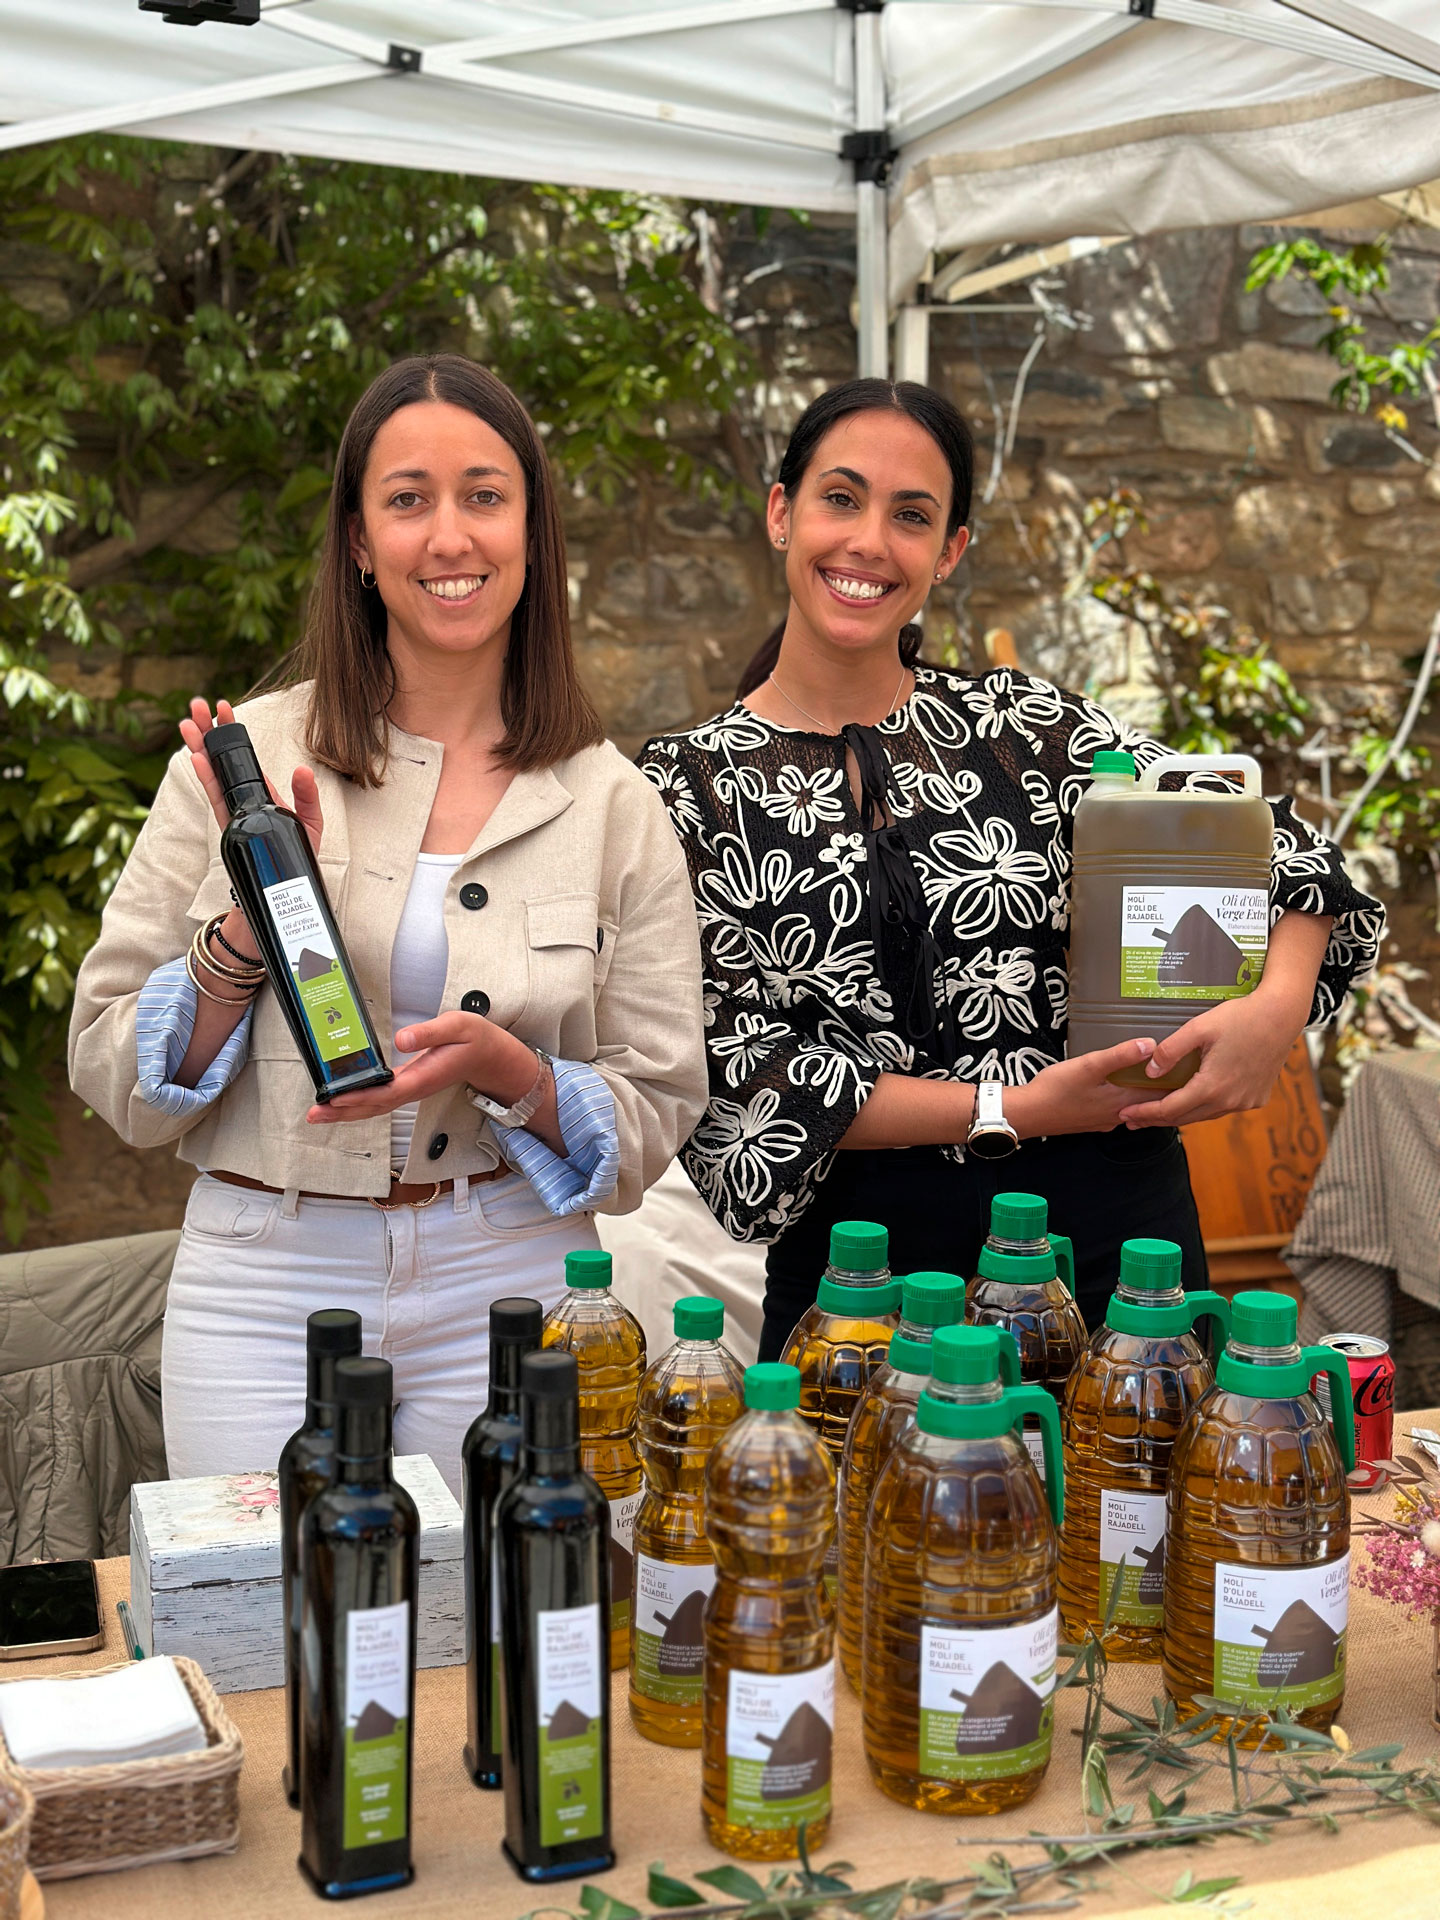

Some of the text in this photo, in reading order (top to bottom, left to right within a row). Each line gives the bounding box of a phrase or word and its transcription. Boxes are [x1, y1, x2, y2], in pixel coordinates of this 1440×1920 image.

[272, 890, 289, 902] MOLÍ
[1128, 895, 1145, 903] MOLÍ
[1222, 895, 1266, 907] Oli d'Oliva
[275, 899, 293, 910] D'OLI
[277, 902, 312, 917] RAJADELL
[1217, 908, 1266, 921] Verge Extra
[303, 922, 320, 931] Extra
[621, 1502, 634, 1515] Oli
[1108, 1503, 1126, 1511] MOLÍ
[1108, 1511, 1126, 1520] D'OLI
[617, 1516, 633, 1528] Ver
[1108, 1520, 1146, 1530] RAJADELL
[641, 1566, 655, 1578] MOLÍ
[1325, 1570, 1337, 1585] Oli
[641, 1575, 656, 1587] D'OLI
[1224, 1577, 1243, 1587] MOLÍ
[641, 1585, 674, 1600] RAJADELL
[1224, 1587, 1257, 1598] D'OLI DE
[1321, 1583, 1341, 1599] Verge
[1224, 1596, 1264, 1608] RAJADELL
[1034, 1628, 1045, 1643] Oli
[356, 1640, 400, 1652] RAJADELL
[547, 1641, 590, 1652] RAJADELL
[930, 1640, 950, 1650] MOLÍ
[1030, 1641, 1049, 1658] Verge
[930, 1650, 965, 1661] D'OLI DE
[930, 1660, 973, 1670] RAJADELL
[736, 1706, 780, 1718] RAJADELL
